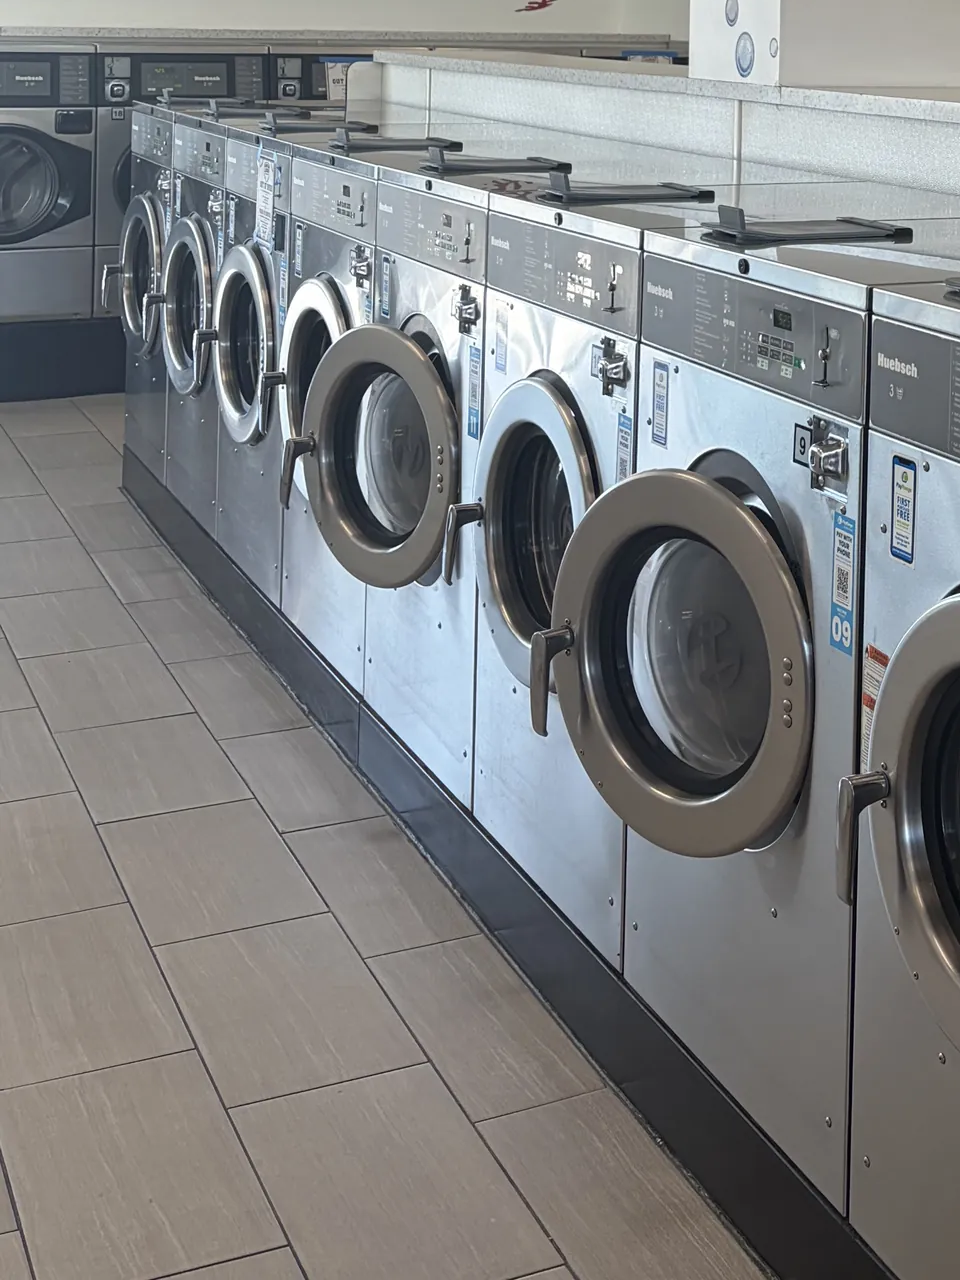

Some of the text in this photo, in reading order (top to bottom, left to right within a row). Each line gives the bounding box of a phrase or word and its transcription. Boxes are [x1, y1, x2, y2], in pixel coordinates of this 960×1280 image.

[877, 352, 918, 379] Huebsch
[889, 383, 895, 398] 3
[799, 436, 806, 456] 9
[896, 508, 910, 523] FREE
[831, 615, 852, 648] 09
